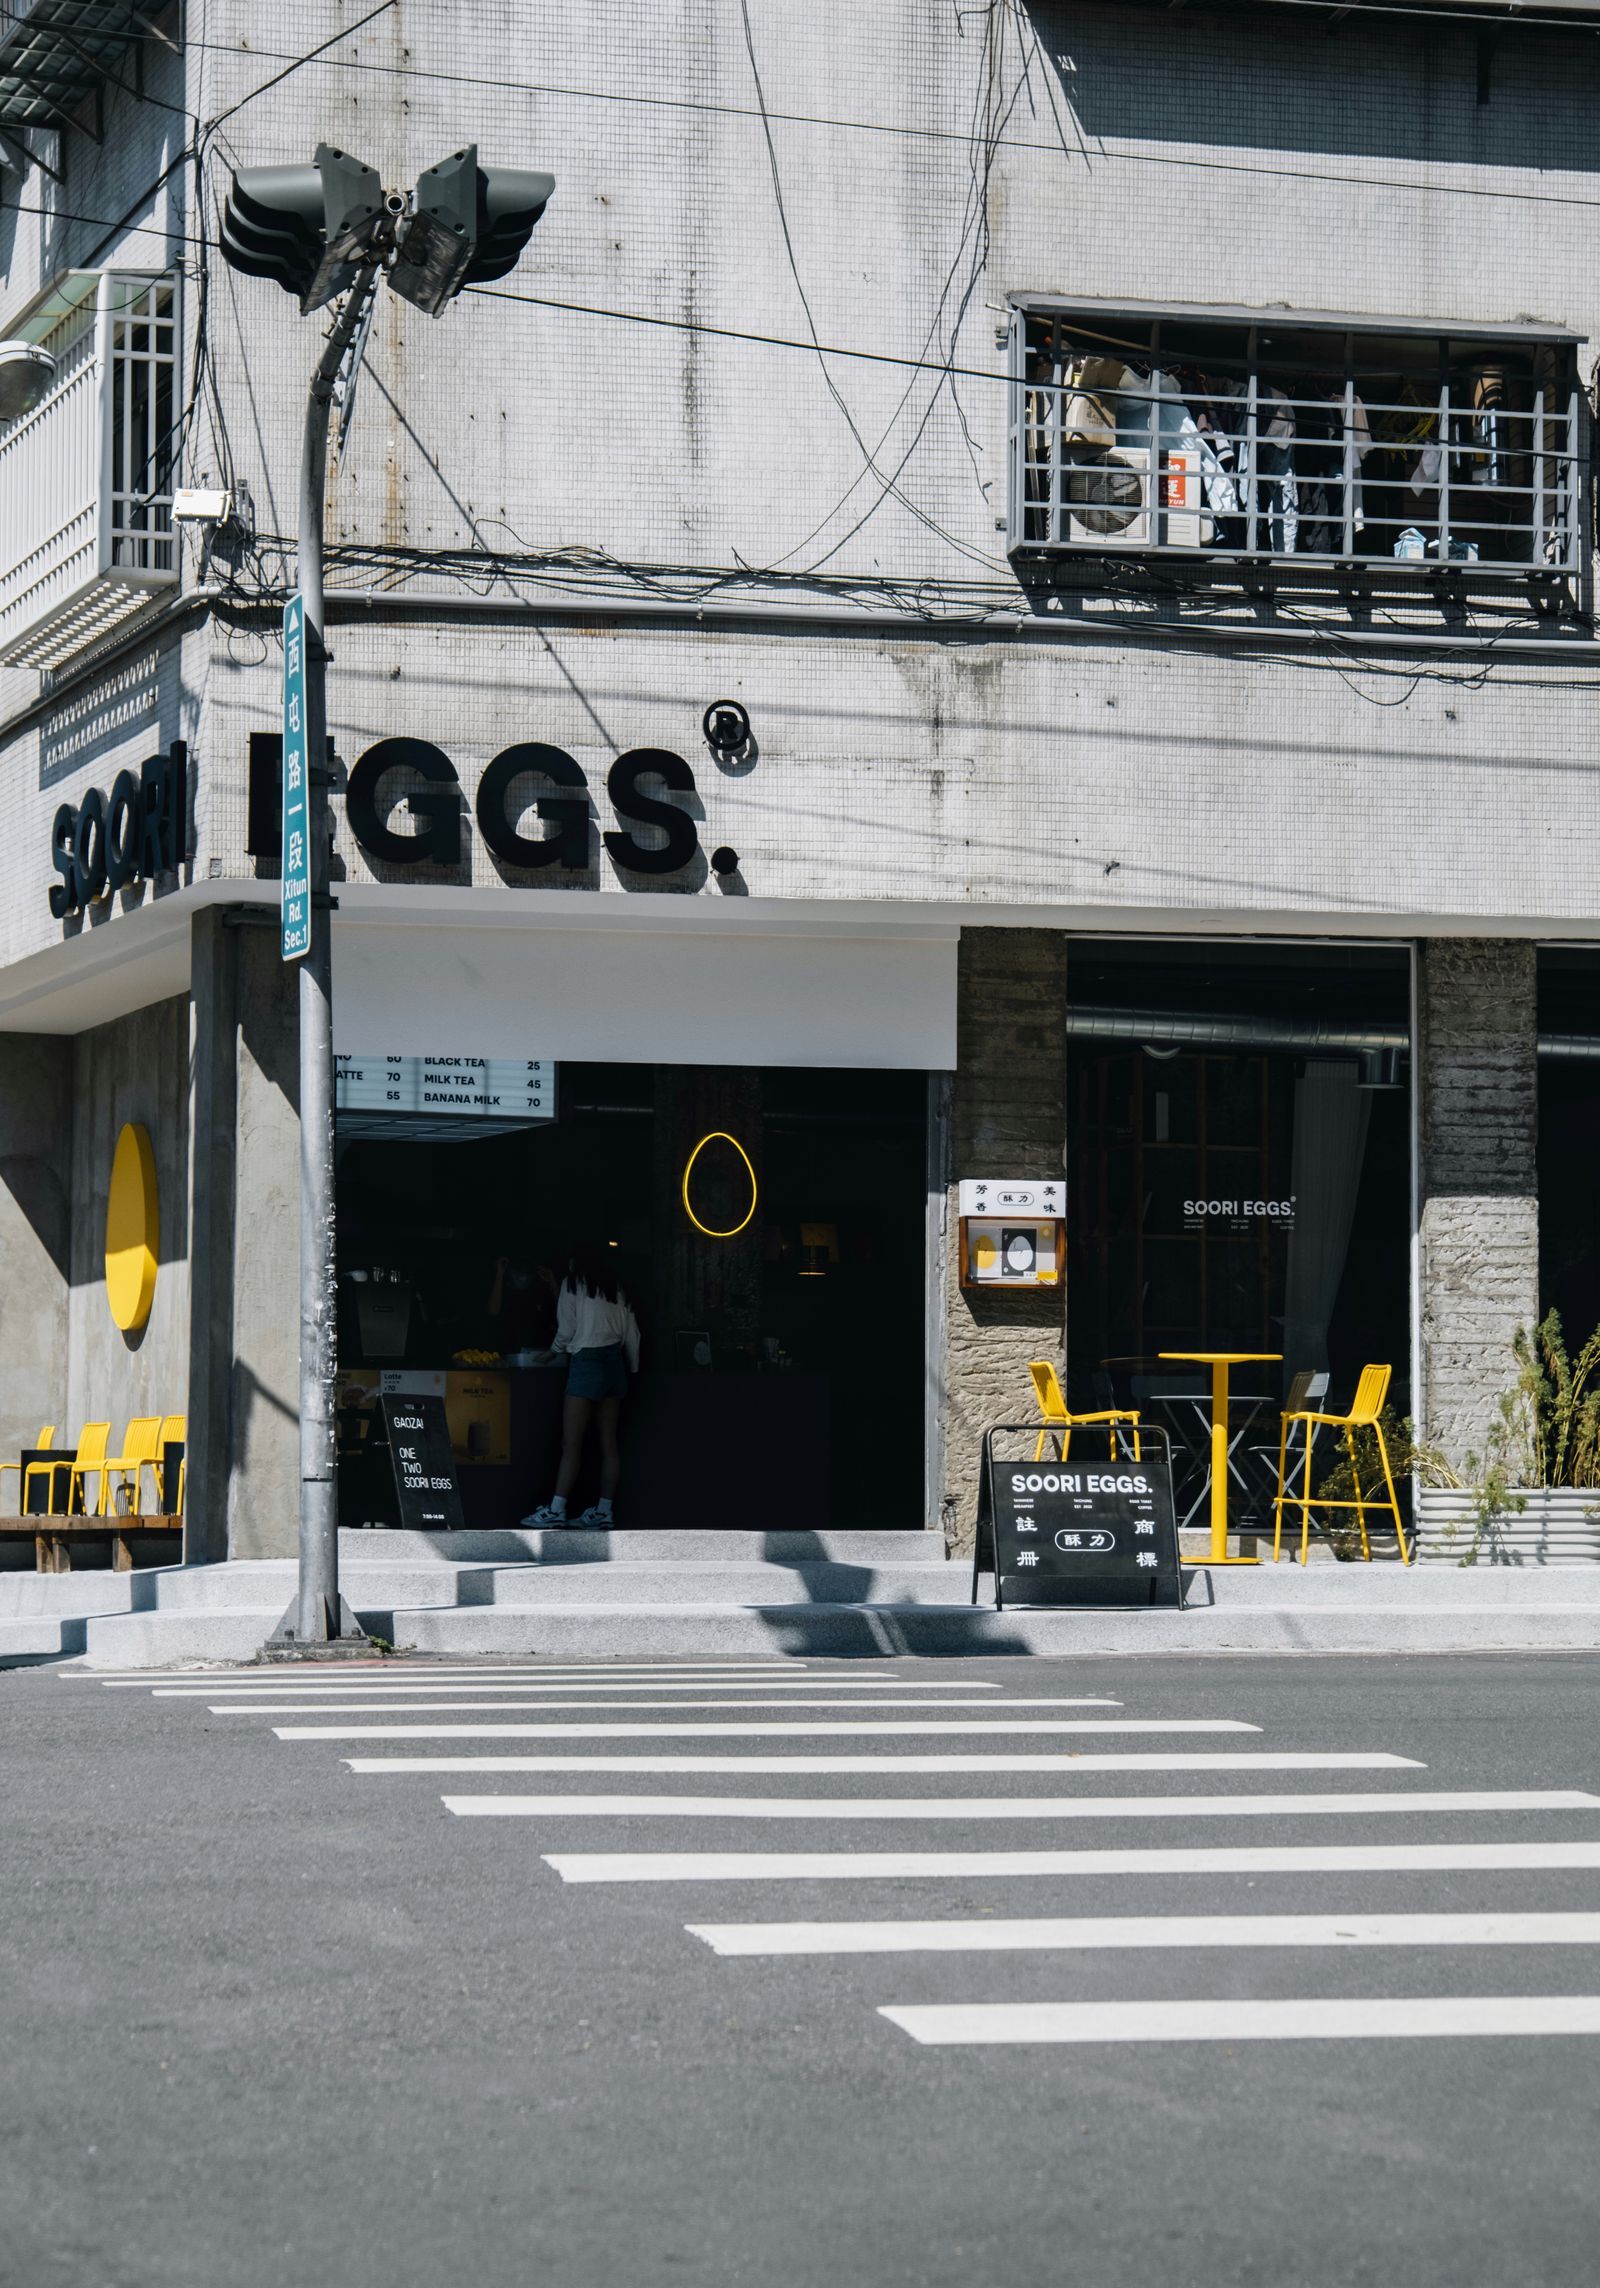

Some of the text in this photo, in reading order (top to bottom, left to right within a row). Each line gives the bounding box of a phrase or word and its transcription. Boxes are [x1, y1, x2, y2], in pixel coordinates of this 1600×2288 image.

[288, 635, 303, 872] 西屯路一段
[48, 740, 187, 919] SOORI
[284, 877, 307, 901] Xitun
[288, 903, 303, 924] Rd.
[284, 924, 307, 950] Sec.1
[424, 1057, 541, 1071] BLACK TEA 25
[386, 1072, 401, 1082] 70
[424, 1074, 541, 1089] MILK TEA 45
[386, 1091, 400, 1100] 55
[424, 1092, 541, 1108] BANANA MILK 70
[976, 1184, 988, 1211] 芳香
[1003, 1194, 1028, 1203] 酥力
[1043, 1186, 1056, 1213] 美味
[1183, 1200, 1296, 1216] SOORI EGGS.
[399, 1447, 417, 1460] ONE
[402, 1462, 422, 1474] TWO
[431, 1477, 453, 1490] EGGS
[1011, 1474, 1153, 1494] SOORI EGGS.
[1064, 1534, 1105, 1547] 酥力
[1134, 1519, 1158, 1568] 商標
